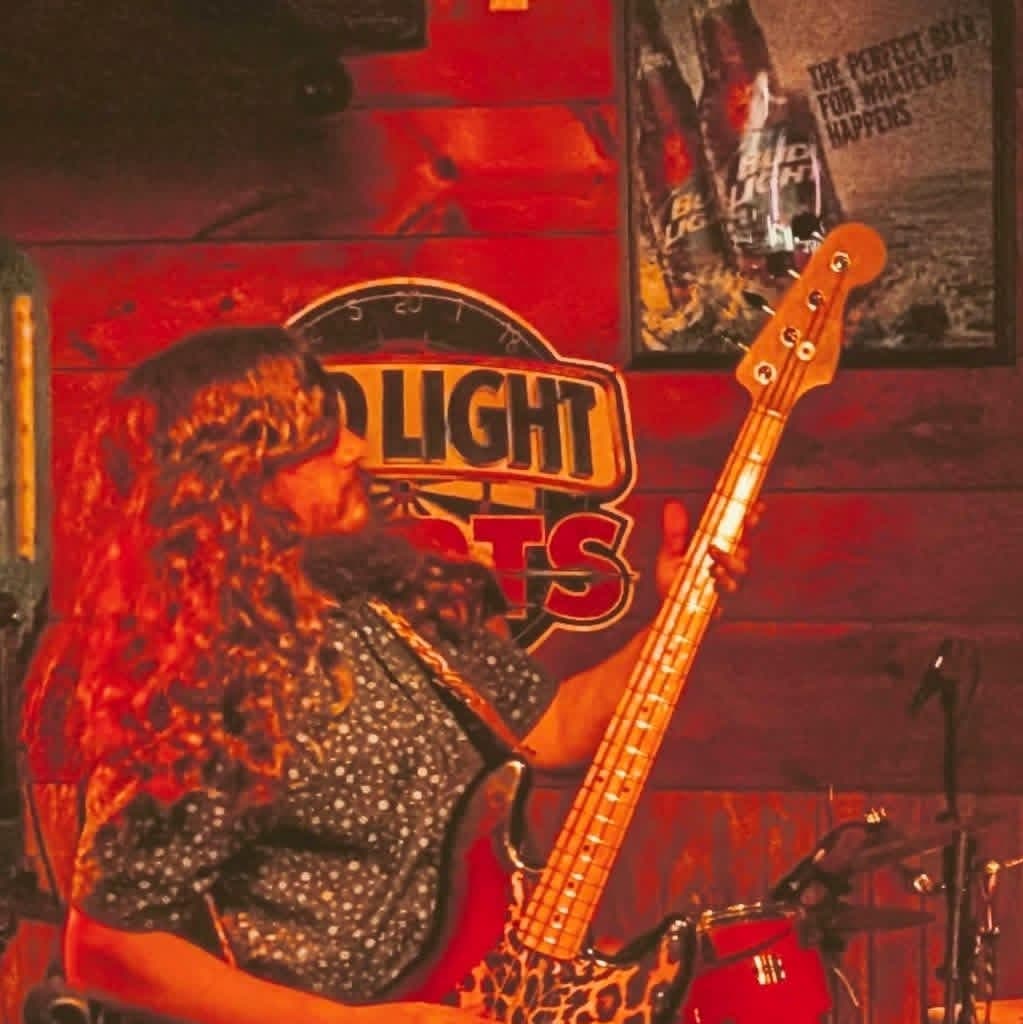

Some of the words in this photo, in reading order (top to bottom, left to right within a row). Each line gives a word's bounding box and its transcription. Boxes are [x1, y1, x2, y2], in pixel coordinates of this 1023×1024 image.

[808, 57, 844, 92] THE
[847, 31, 926, 80] PERFECT
[817, 86, 856, 121] FOR
[859, 52, 957, 105] WHATEVER
[826, 98, 913, 149] HAPPENS
[382, 368, 596, 481] LIGHT
